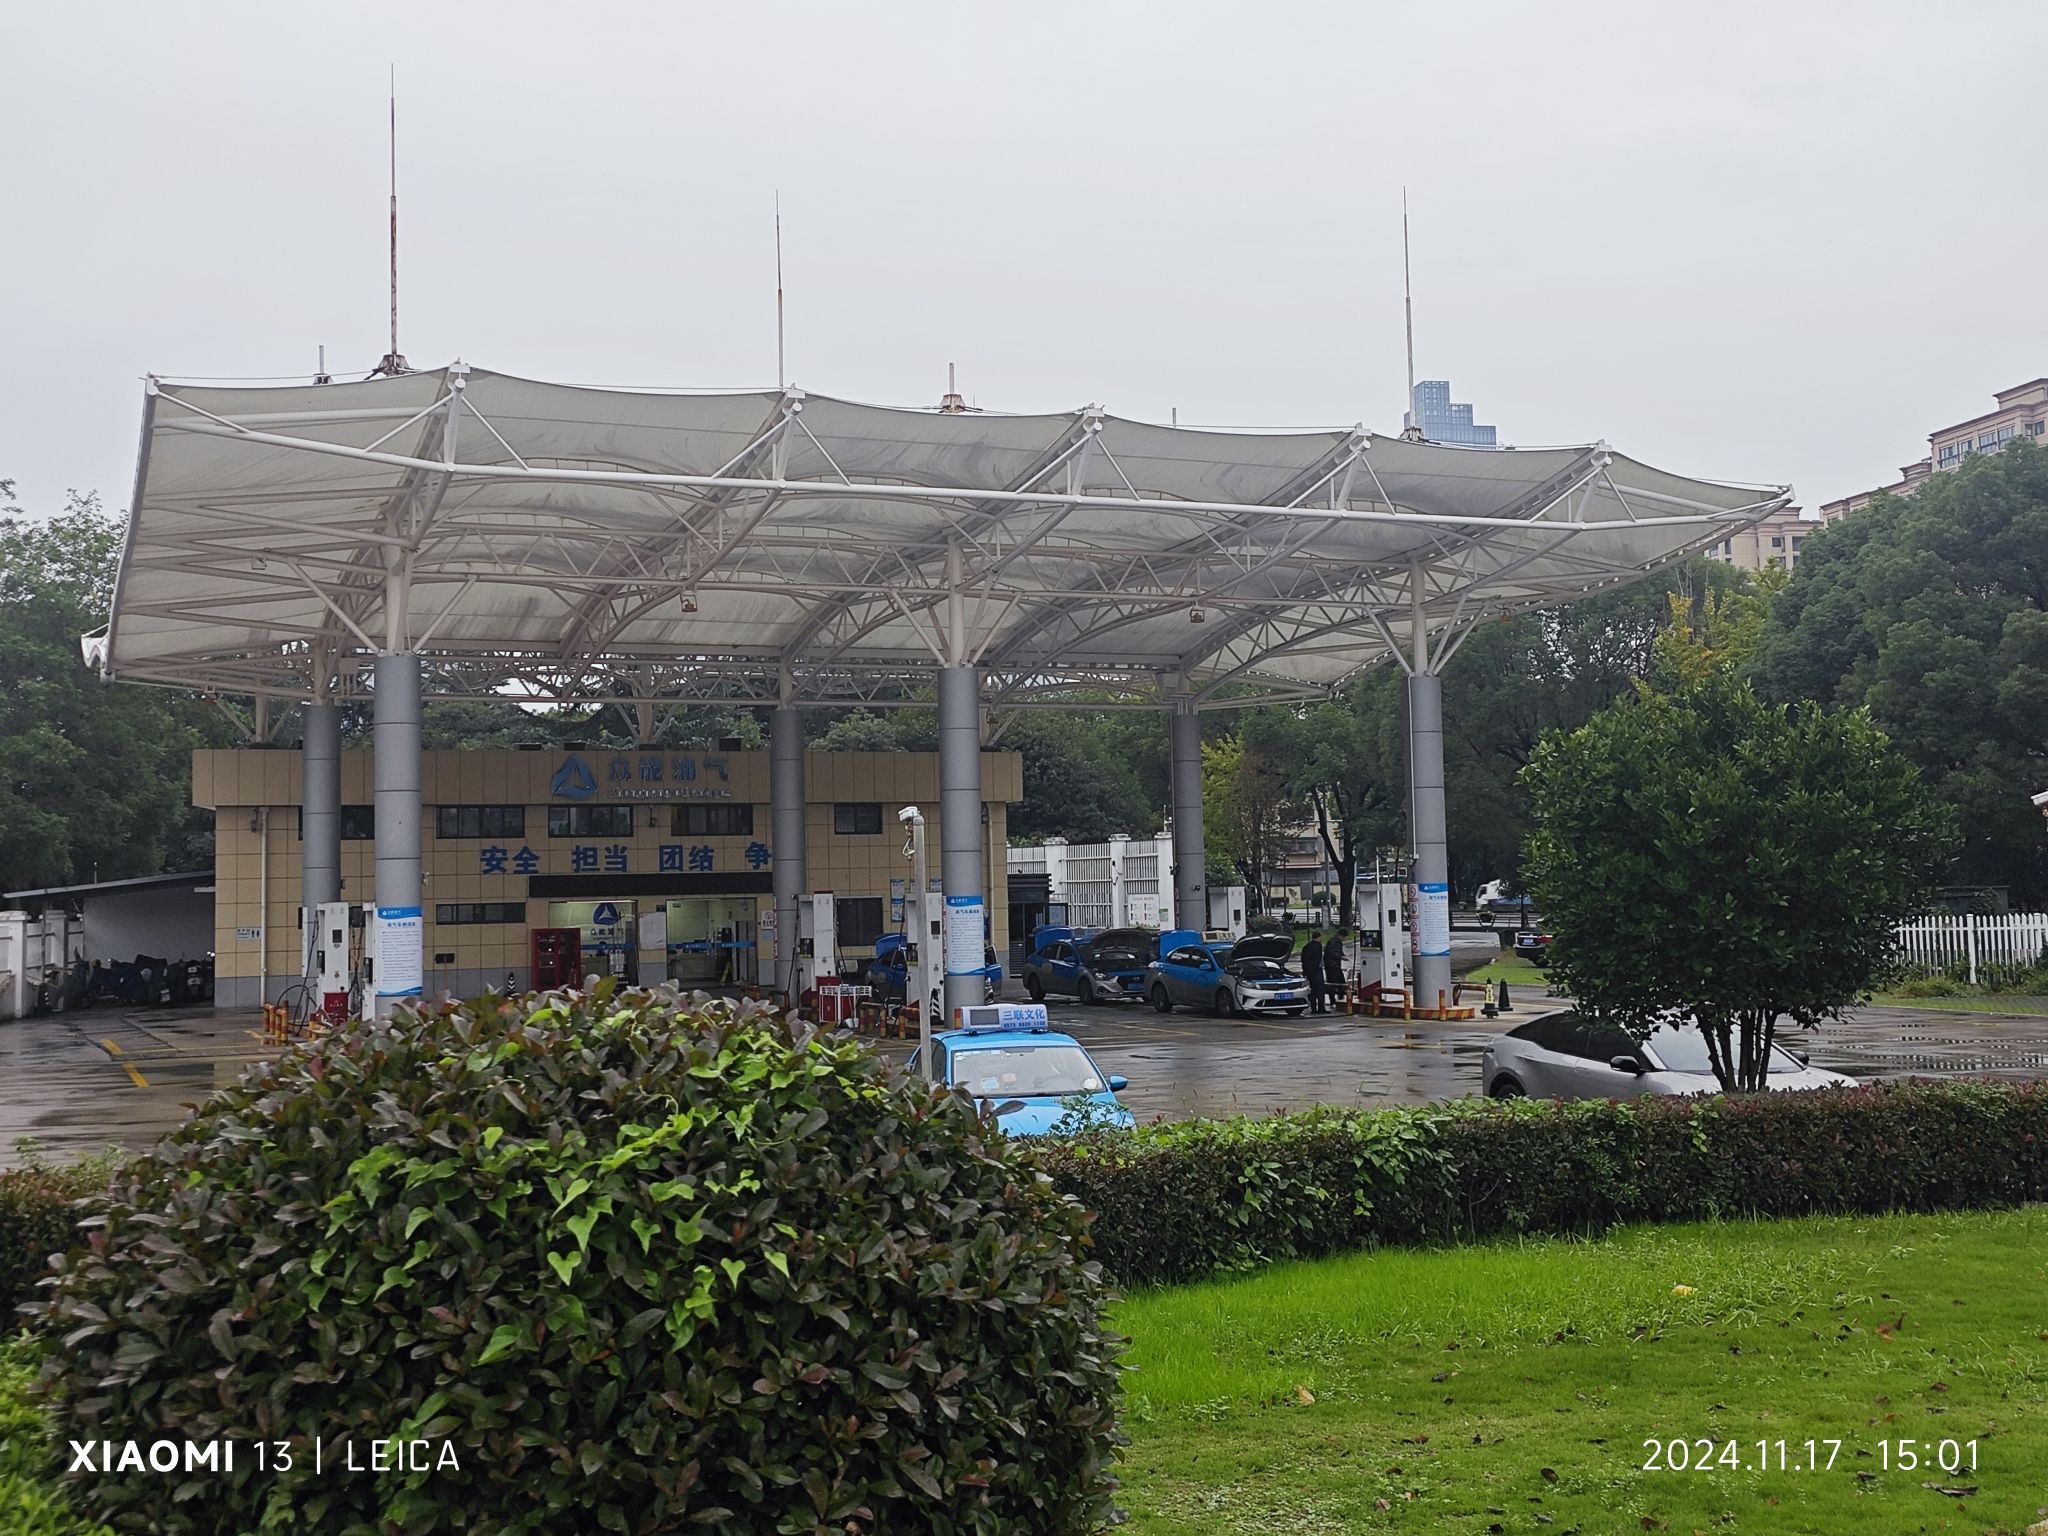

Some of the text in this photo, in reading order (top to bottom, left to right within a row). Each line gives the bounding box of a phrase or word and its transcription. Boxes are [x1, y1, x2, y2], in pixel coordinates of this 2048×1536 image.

[607, 755, 729, 781] 众能油气
[480, 845, 540, 875] 安全
[571, 844, 628, 873] 担当
[658, 844, 715, 872] 团结
[1002, 1008, 1045, 1020] 三联文化
